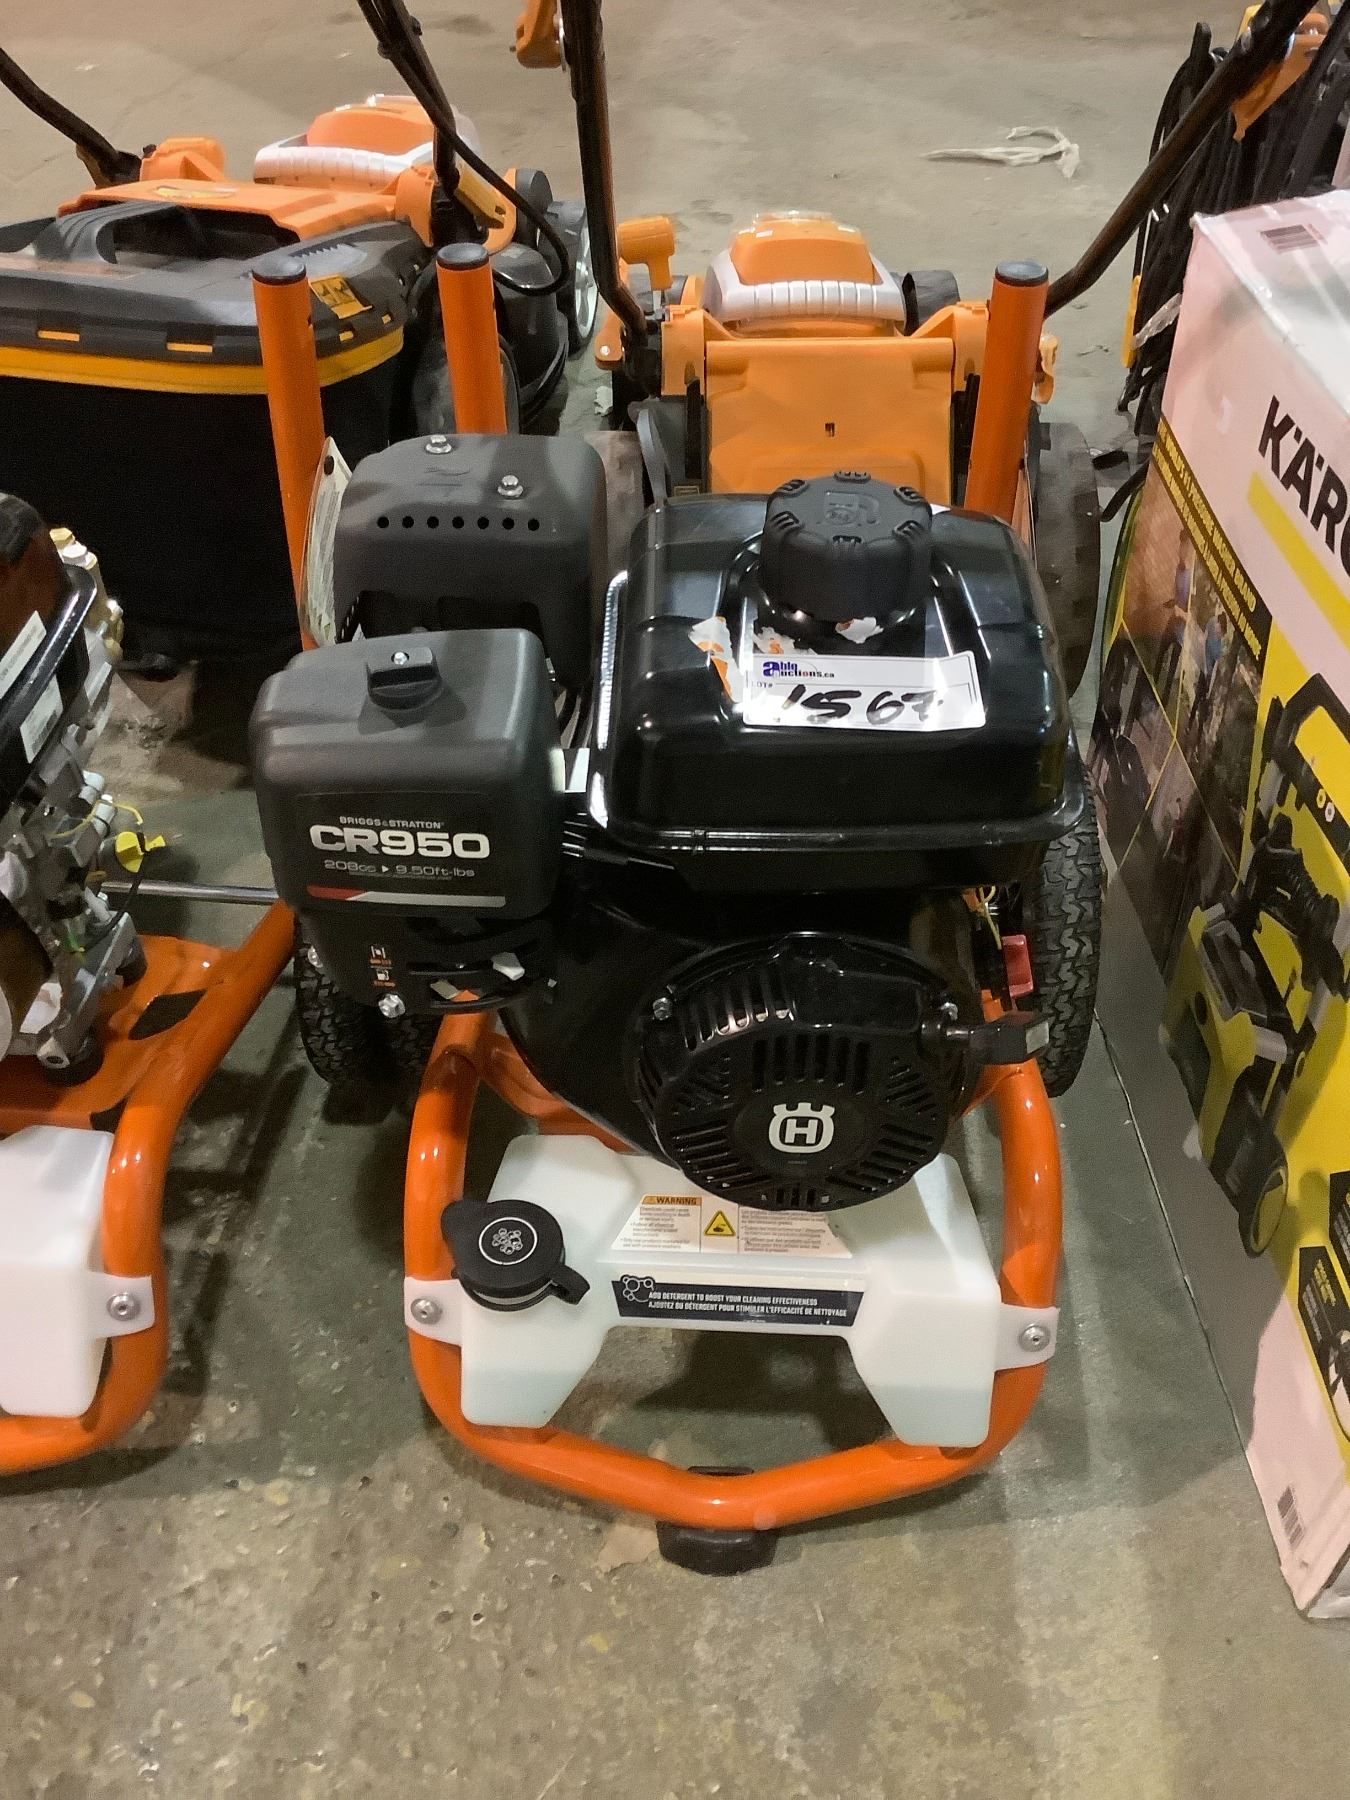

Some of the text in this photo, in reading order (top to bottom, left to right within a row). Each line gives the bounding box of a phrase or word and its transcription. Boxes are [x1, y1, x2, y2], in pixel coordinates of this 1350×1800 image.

[1258, 395, 1350, 577] KÄR
[309, 824, 491, 859] CR950
[324, 859, 377, 874] 208cc
[656, 1196, 697, 1205] WARNING
[649, 1291, 661, 1299] ADD
[662, 1292, 695, 1301] DETERGENT
[705, 1294, 724, 1302] BOOST
[725, 1295, 741, 1303] YOUR
[742, 1296, 771, 1304] CLEANING
[772, 1297, 818, 1306] EFFECTIVENESS
[648, 1301, 674, 1309] AJOUTEZ
[684, 1301, 718, 1311] DÉTERGENT
[719, 1304, 735, 1312] POUR
[736, 1305, 765, 1313] STIMULER
[766, 1306, 803, 1315] L'EFFICACITÉ
[804, 1307, 812, 1315] DE
[813, 1308, 848, 1317] NETTOYAGE
